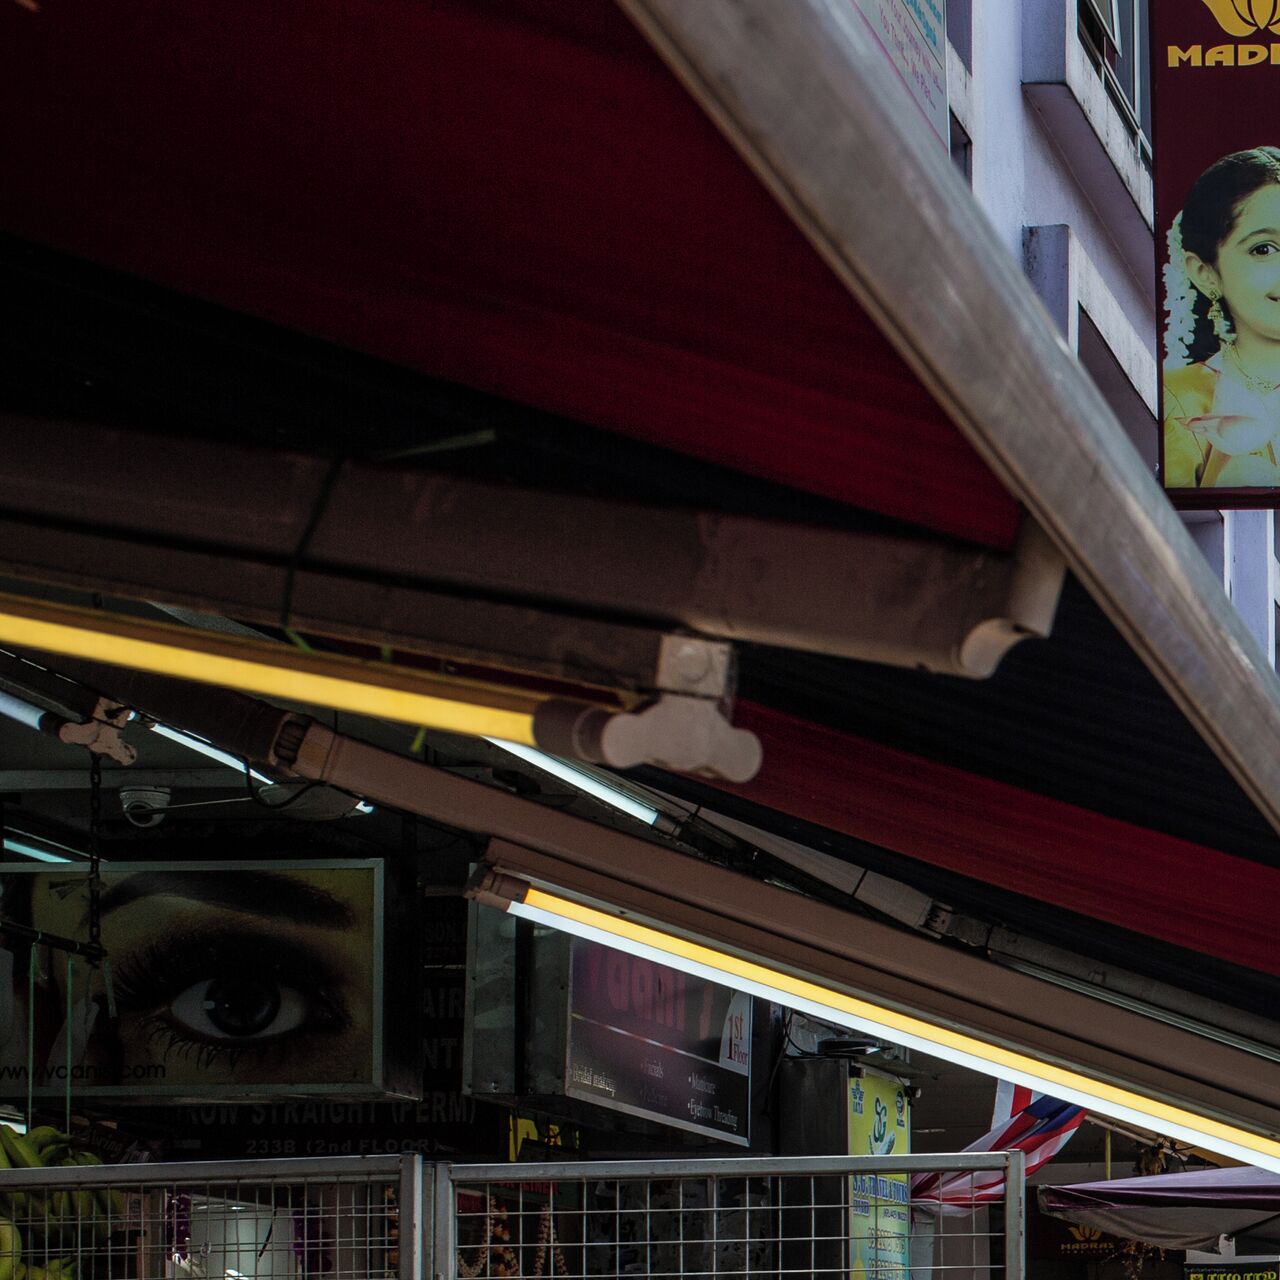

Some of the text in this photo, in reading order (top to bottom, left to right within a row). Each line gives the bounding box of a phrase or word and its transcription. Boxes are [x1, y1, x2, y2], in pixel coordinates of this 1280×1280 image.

[391, 1093, 477, 1125] (PERM)
[245, 1139, 296, 1153] 233B
[1060, 1242, 1116, 1250] MADRAS
